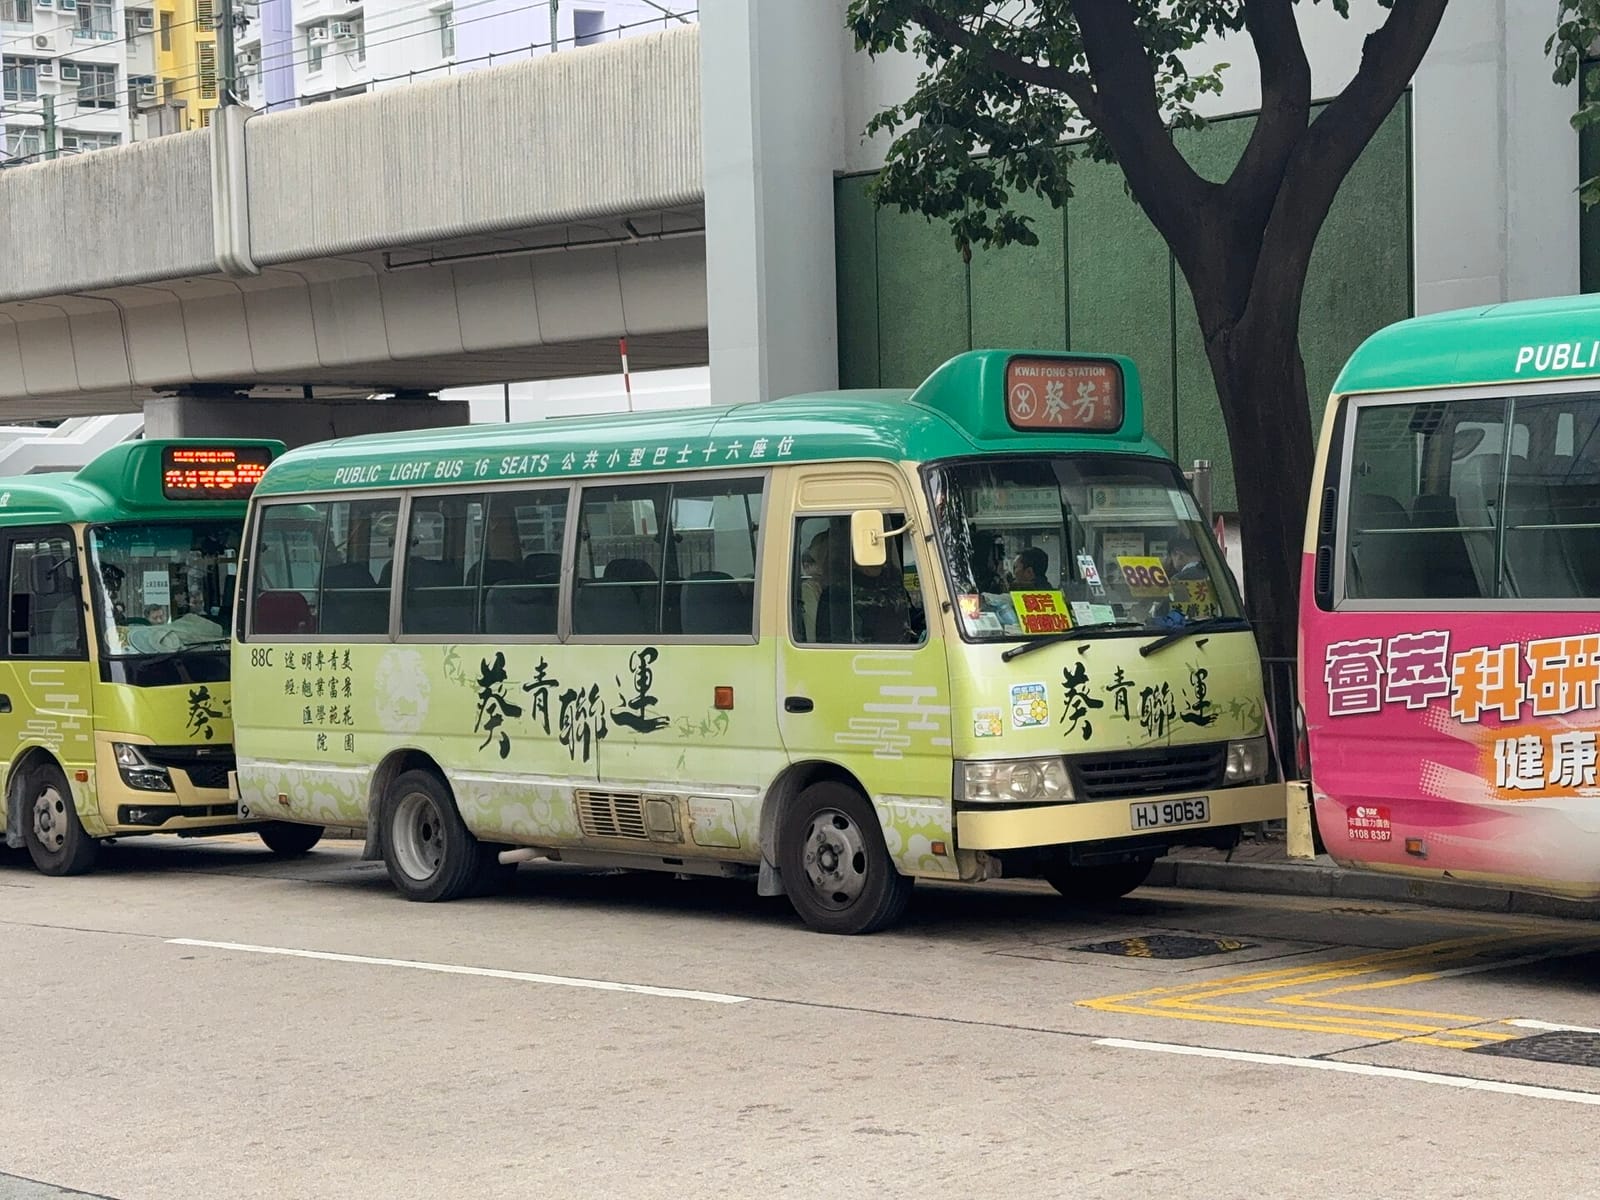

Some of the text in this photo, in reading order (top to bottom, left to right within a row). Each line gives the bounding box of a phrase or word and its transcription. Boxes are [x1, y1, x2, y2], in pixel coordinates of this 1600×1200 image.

[1015, 366, 1106, 377] KWAI FONG STATION
[1514, 340, 1600, 374] PUBLI
[1041, 380, 1098, 424] 葵芳
[333, 436, 795, 485] PUBLIC LIGHT BUS 16 SEATS 公共小型巴士十六座位
[1121, 565, 1171, 588] 88G
[250, 647, 274, 668] 88C
[1325, 630, 1600, 723] 薈萃科研
[186, 684, 232, 740] 葵
[474, 646, 671, 782] 葵青聯運
[1059, 661, 1219, 746] 葵青聯運
[1494, 731, 1598, 790] 健康
[1136, 801, 1206, 828] HJ 9063
[1349, 829, 1391, 841] 8108 8387
